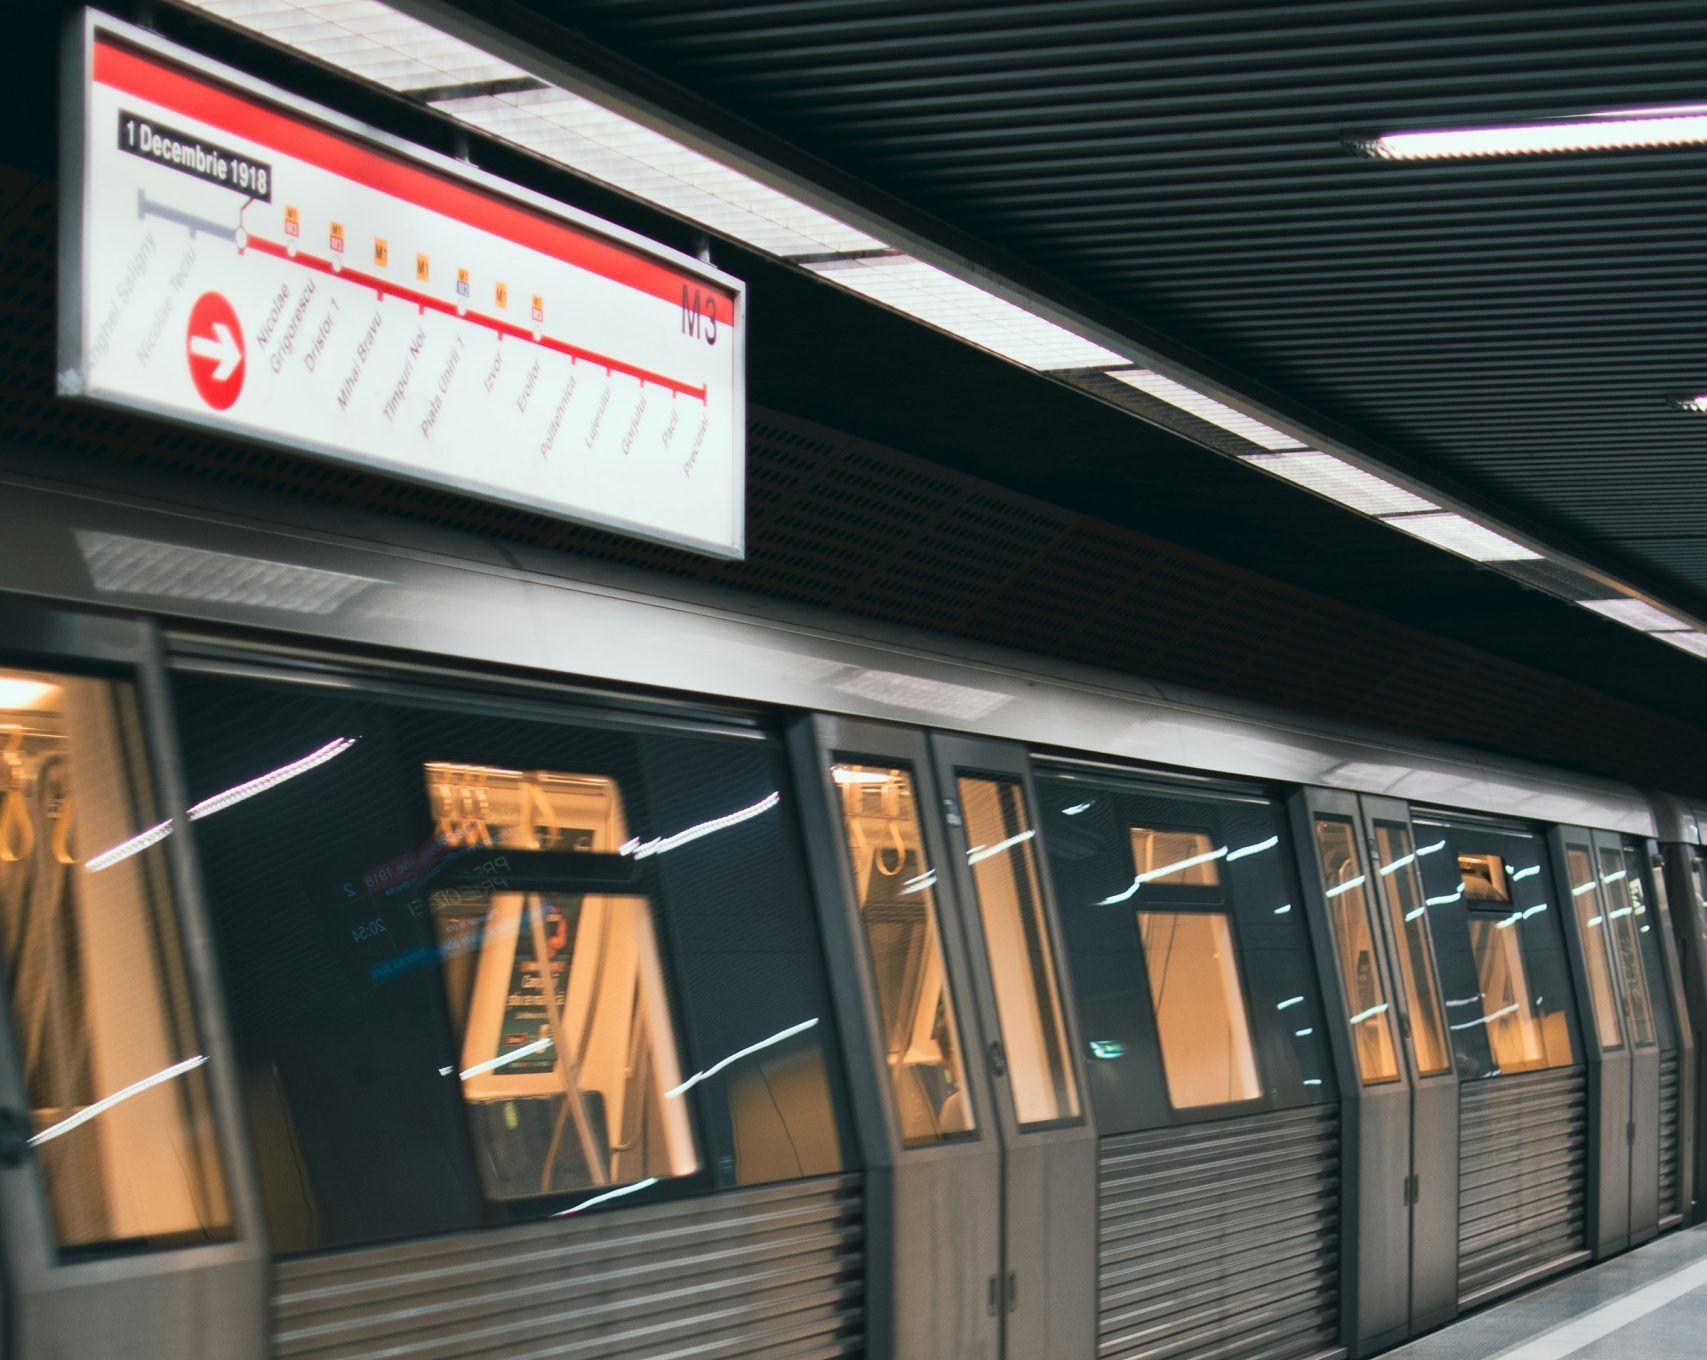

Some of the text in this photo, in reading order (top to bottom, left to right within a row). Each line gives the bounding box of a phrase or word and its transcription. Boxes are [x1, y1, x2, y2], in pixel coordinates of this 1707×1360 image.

[126, 120, 268, 195] 1 Decembrie 1918
[286, 207, 299, 220] M1
[331, 224, 343, 237] M1
[116, 228, 158, 305] Saligny
[375, 244, 388, 262] M1
[417, 260, 429, 276] M1
[136, 244, 198, 368] Nicolae Teclu
[256, 282, 291, 351] Nicolae
[270, 277, 317, 375] Grigorescu
[495, 287, 507, 304] M1
[682, 283, 718, 346] M3
[303, 314, 335, 373] Dristor
[336, 311, 383, 411] Mihai Bravu
[439, 348, 460, 394] Unirii
[483, 350, 504, 394] Izvor
[382, 328, 427, 424] Timpuri Noi
[516, 359, 543, 414] Eroilor
[540, 375, 577, 460] Politehnica
[584, 384, 613, 449] Lujerului
[621, 395, 648, 456] Gorjului
[661, 409, 680, 448] Pacii
[683, 414, 710, 478] Preciziei
